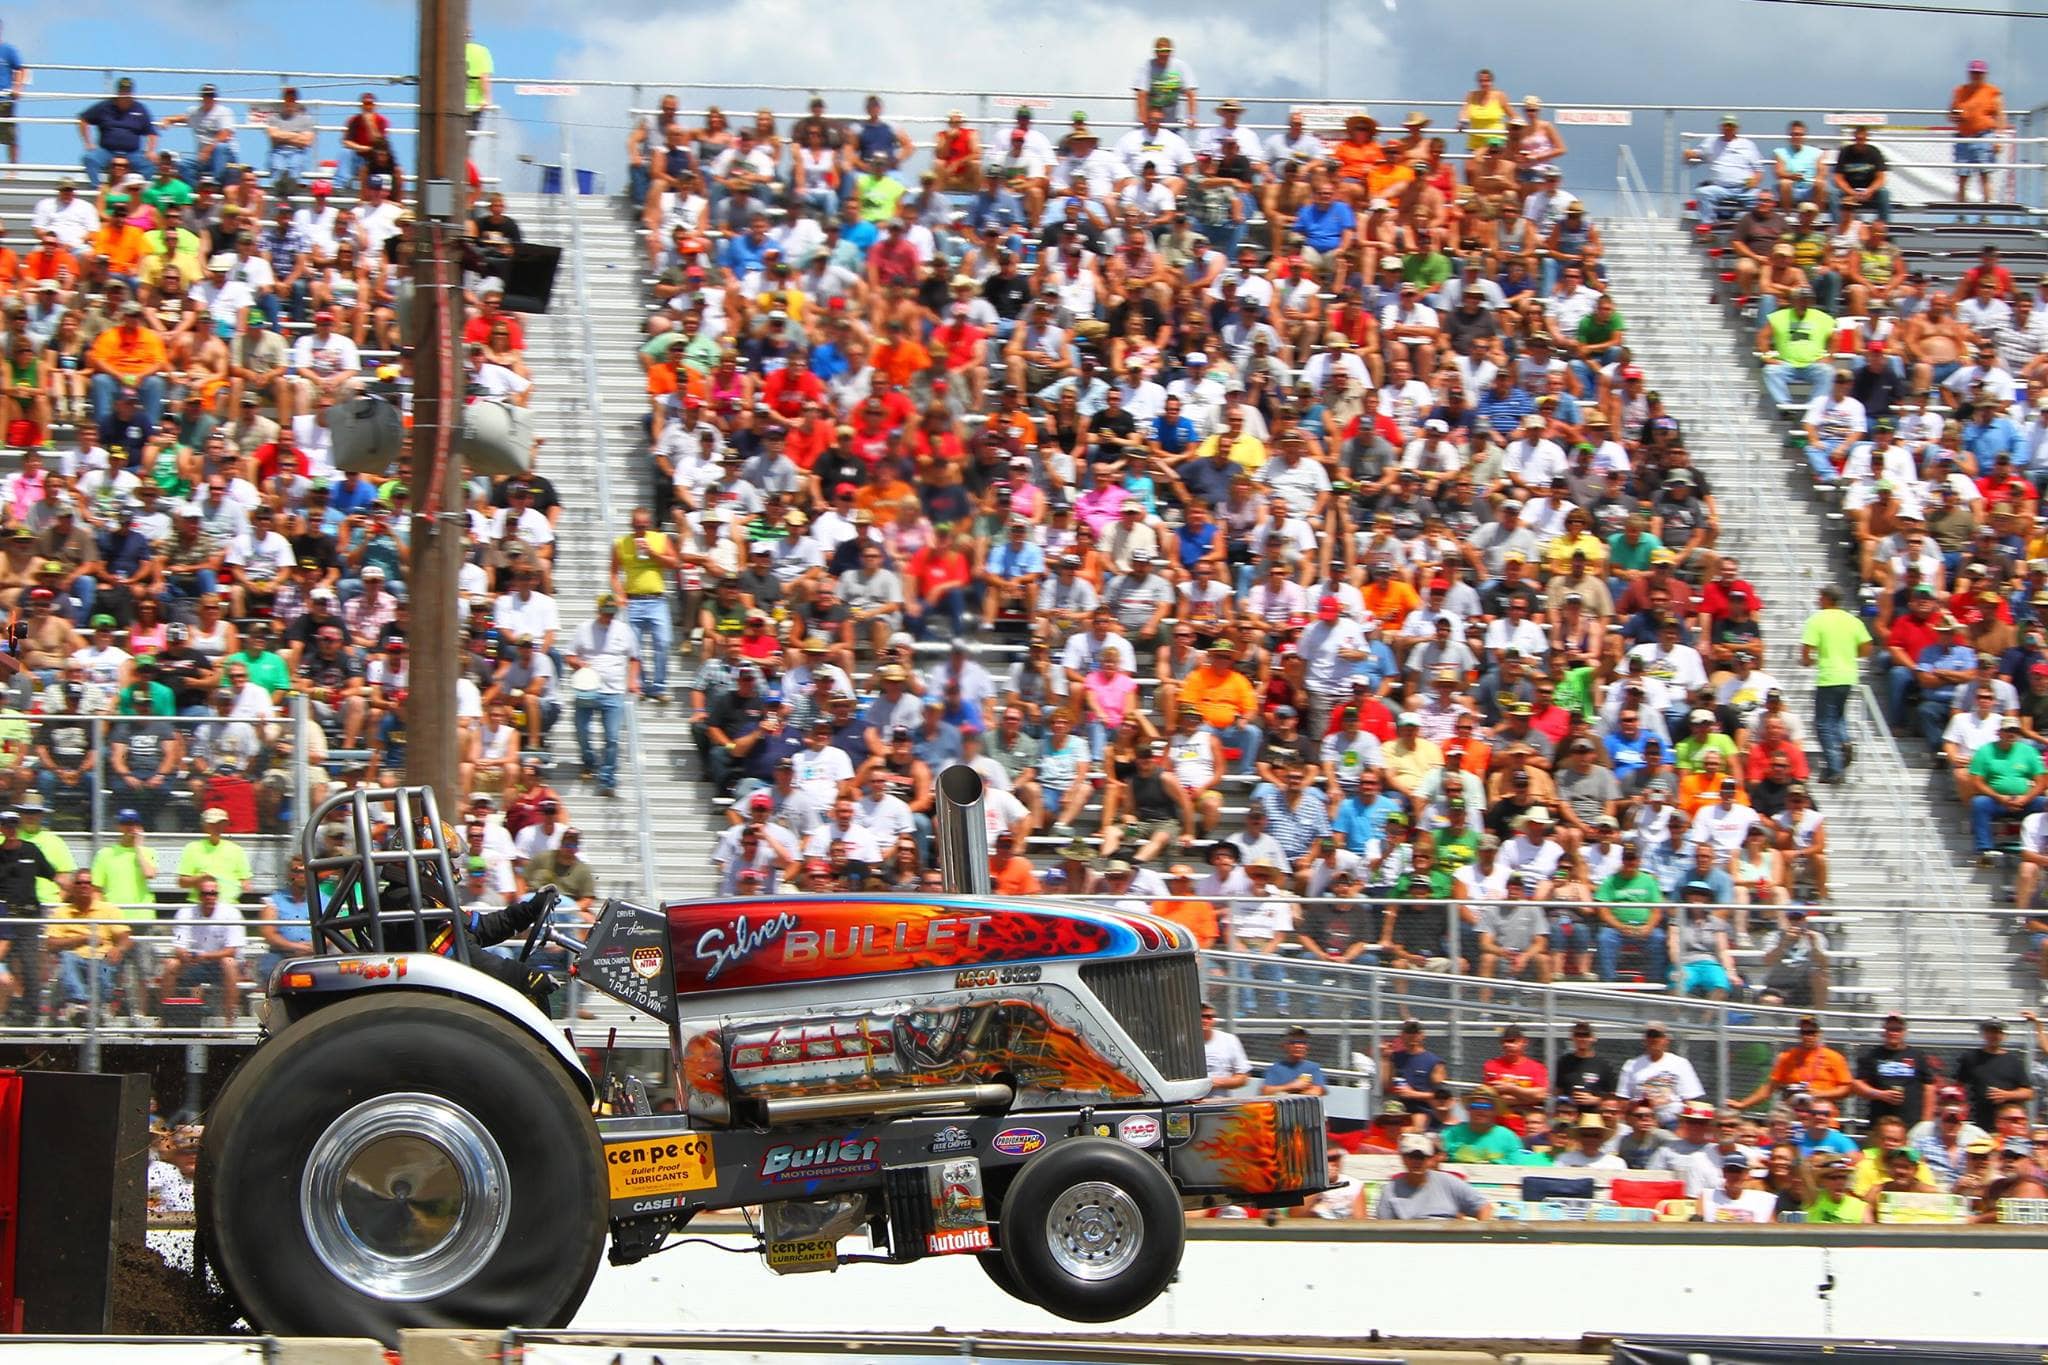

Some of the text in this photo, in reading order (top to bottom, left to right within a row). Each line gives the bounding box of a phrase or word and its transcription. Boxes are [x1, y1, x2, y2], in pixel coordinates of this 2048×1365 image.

[617, 910, 636, 918] DRIVER
[696, 911, 797, 980] Silver
[782, 916, 992, 963] BULLET
[613, 982, 635, 998] PLAY
[635, 992, 647, 1005] TO
[762, 1139, 878, 1176] Bullet
[631, 1164, 680, 1175] Bullet Proof
[781, 1164, 872, 1180] MOTORSPORTS
[625, 1171, 689, 1185] LUBRICANTS
[633, 1198, 673, 1212] CASE
[929, 1230, 990, 1251] Autolite
[773, 1253, 825, 1263] LUBRICANTS
